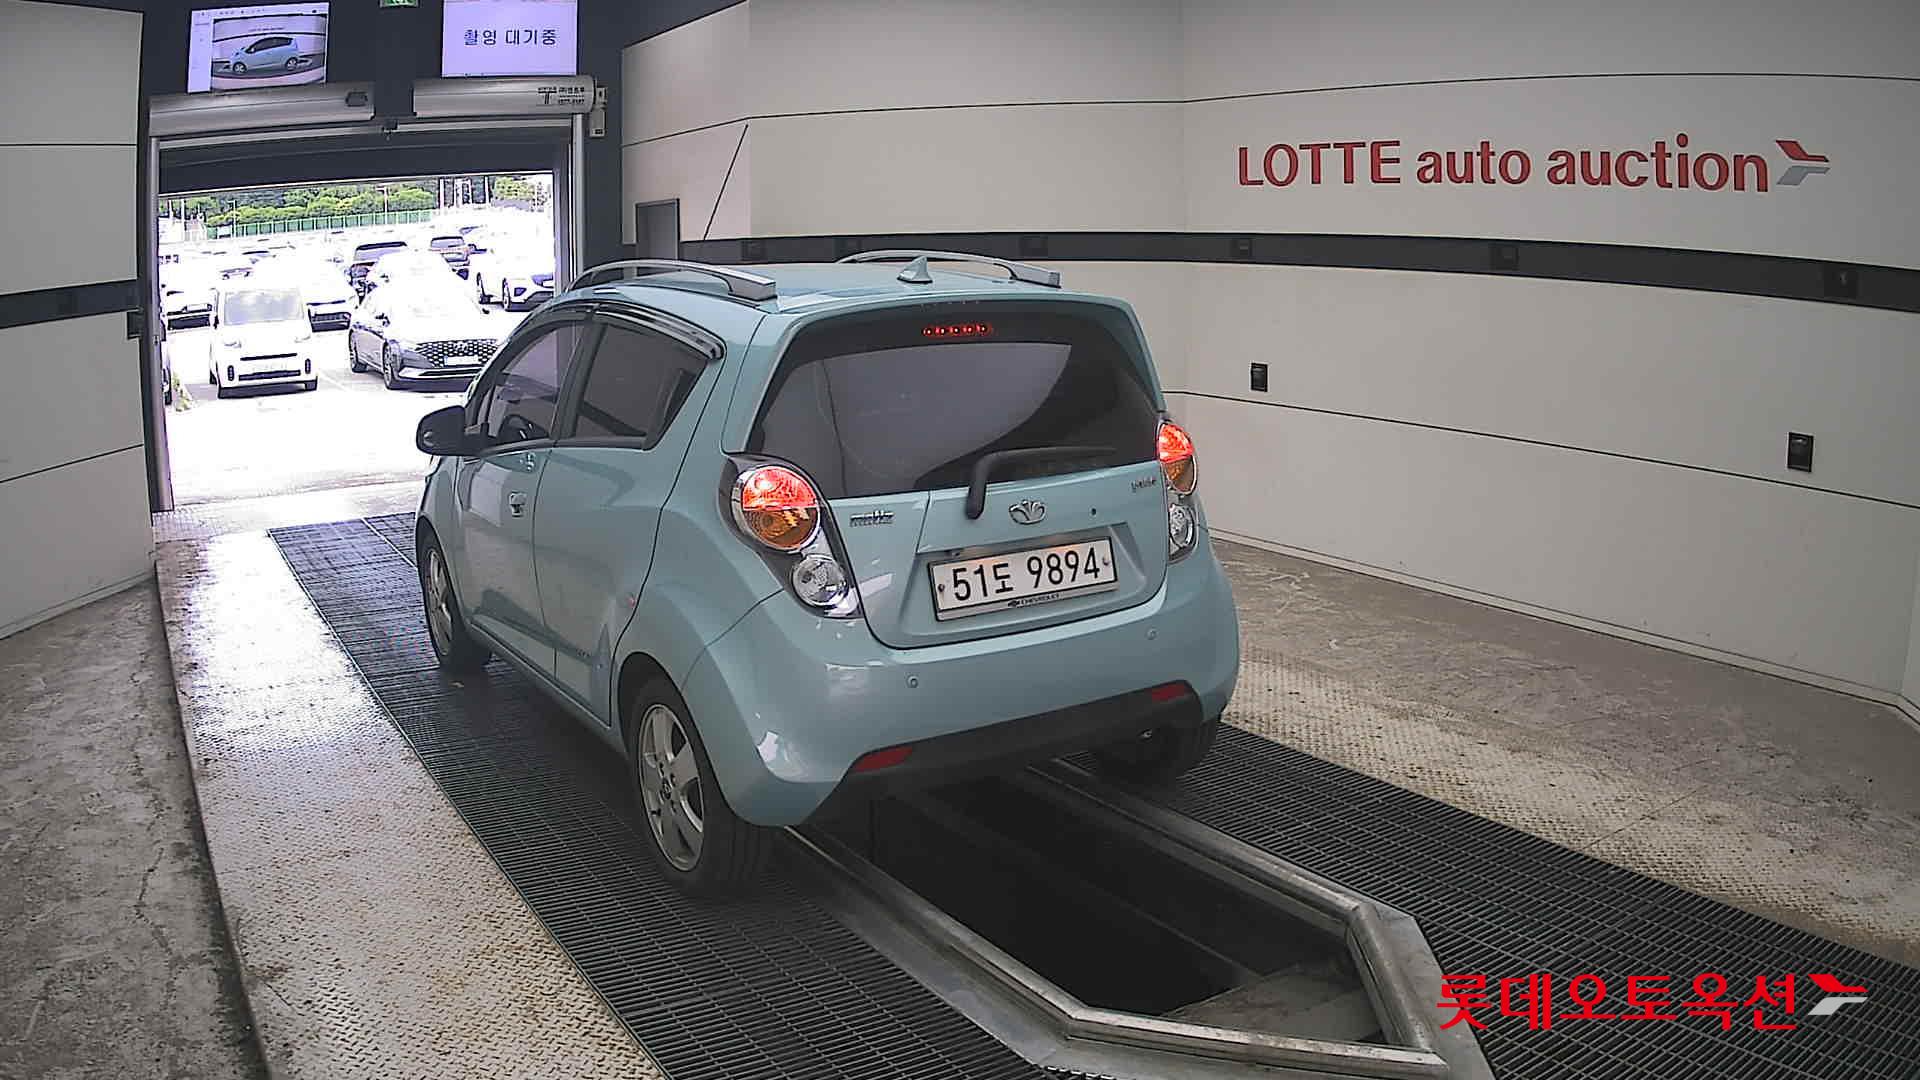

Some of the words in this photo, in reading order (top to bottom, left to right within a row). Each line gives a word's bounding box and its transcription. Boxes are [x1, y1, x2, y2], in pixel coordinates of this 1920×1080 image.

[464, 29, 497, 46] 촬영
[504, 29, 557, 46] 대기중
[1239, 140, 1402, 188] LOTTE
[1416, 140, 1533, 186] auto
[1547, 134, 1769, 192] auction
[951, 561, 1014, 602] 51도
[1026, 547, 1101, 589] 9894
